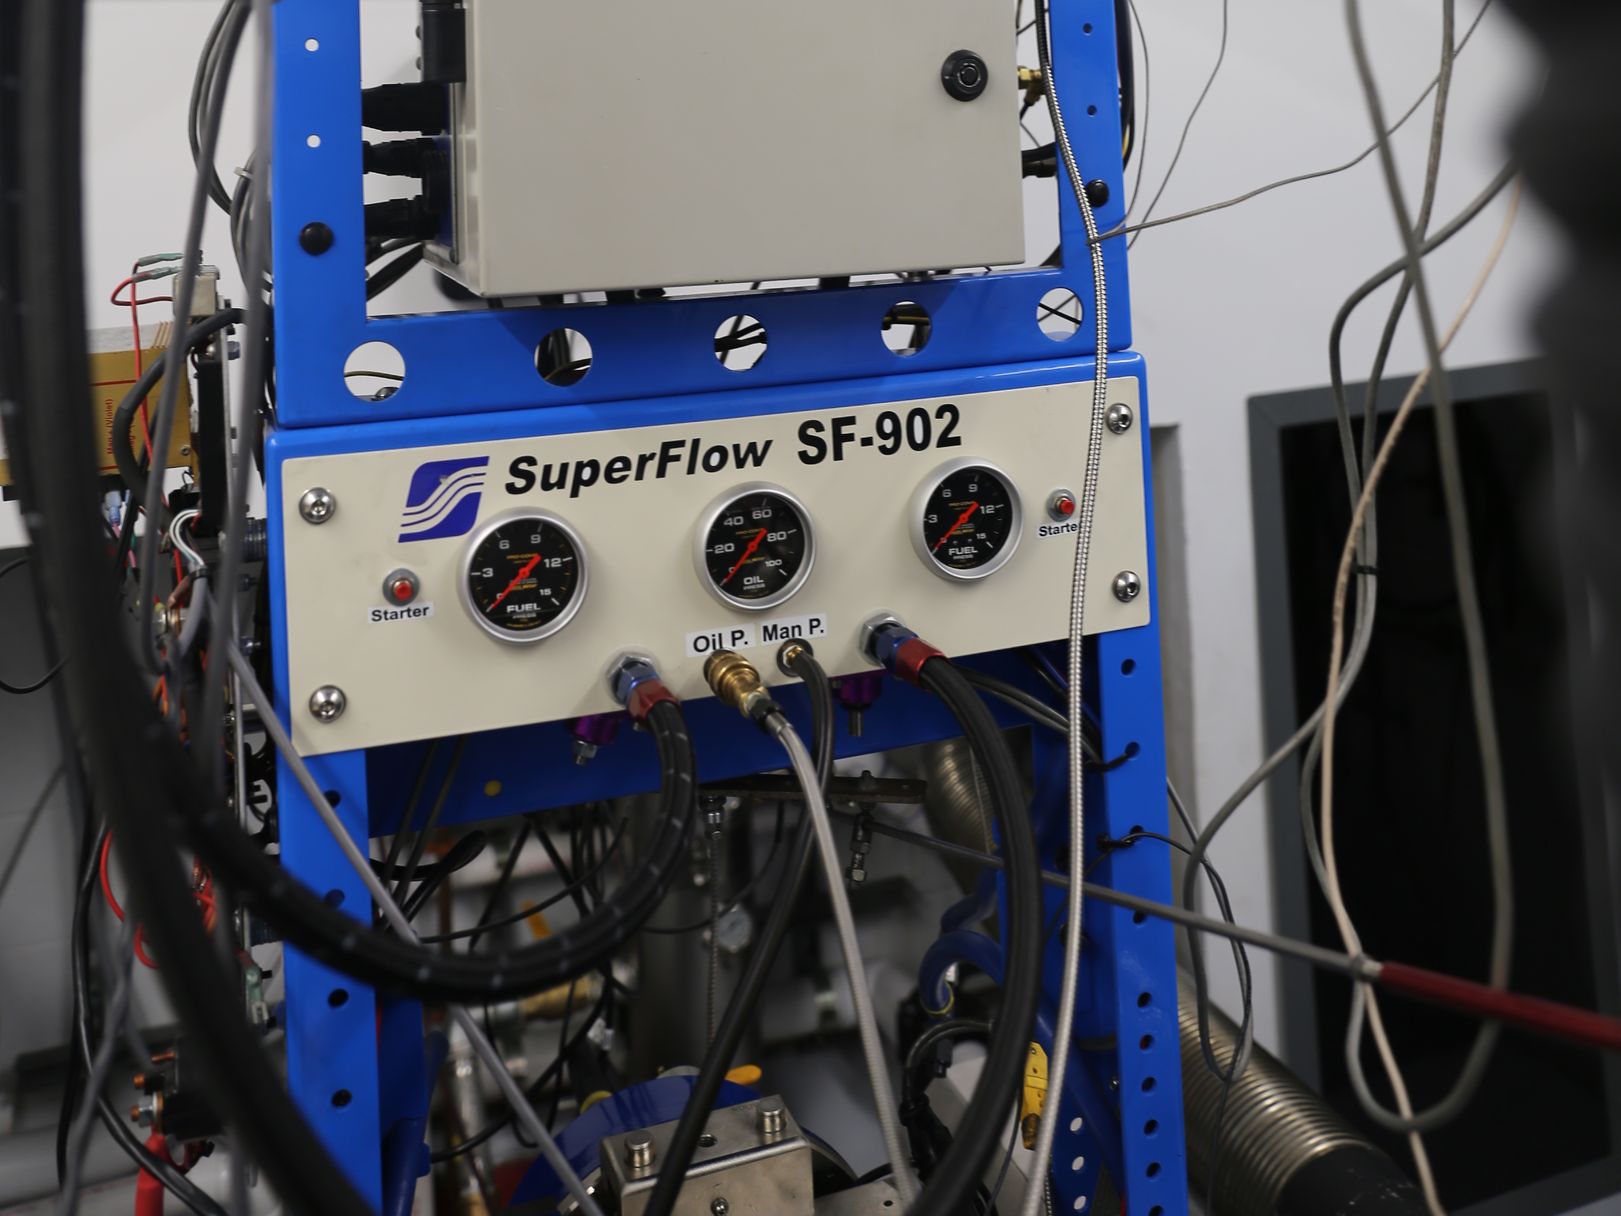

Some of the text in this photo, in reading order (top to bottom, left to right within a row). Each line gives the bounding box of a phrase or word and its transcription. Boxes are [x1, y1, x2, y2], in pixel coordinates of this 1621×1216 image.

[504, 403, 963, 498] SuperFlow SF-902
[942, 489, 952, 498] 6
[968, 484, 979, 493] 9
[752, 508, 773, 520] 60
[980, 504, 996, 515] 12
[723, 515, 744, 527] 40
[928, 514, 939, 524] 3
[1038, 522, 1079, 538] Starte
[530, 534, 542, 544] 9
[767, 530, 788, 542] 80
[499, 539, 510, 550] 6
[714, 542, 735, 554] 20
[948, 546, 979, 556] FUEL
[543, 557, 562, 568] 12
[765, 558, 783, 568] 100
[482, 567, 494, 578] 3
[743, 575, 765, 586] OIL
[506, 602, 542, 613] FUEL
[371, 606, 430, 622] Starter
[762, 617, 825, 642] Man P.
[693, 629, 749, 653] Oil P.
